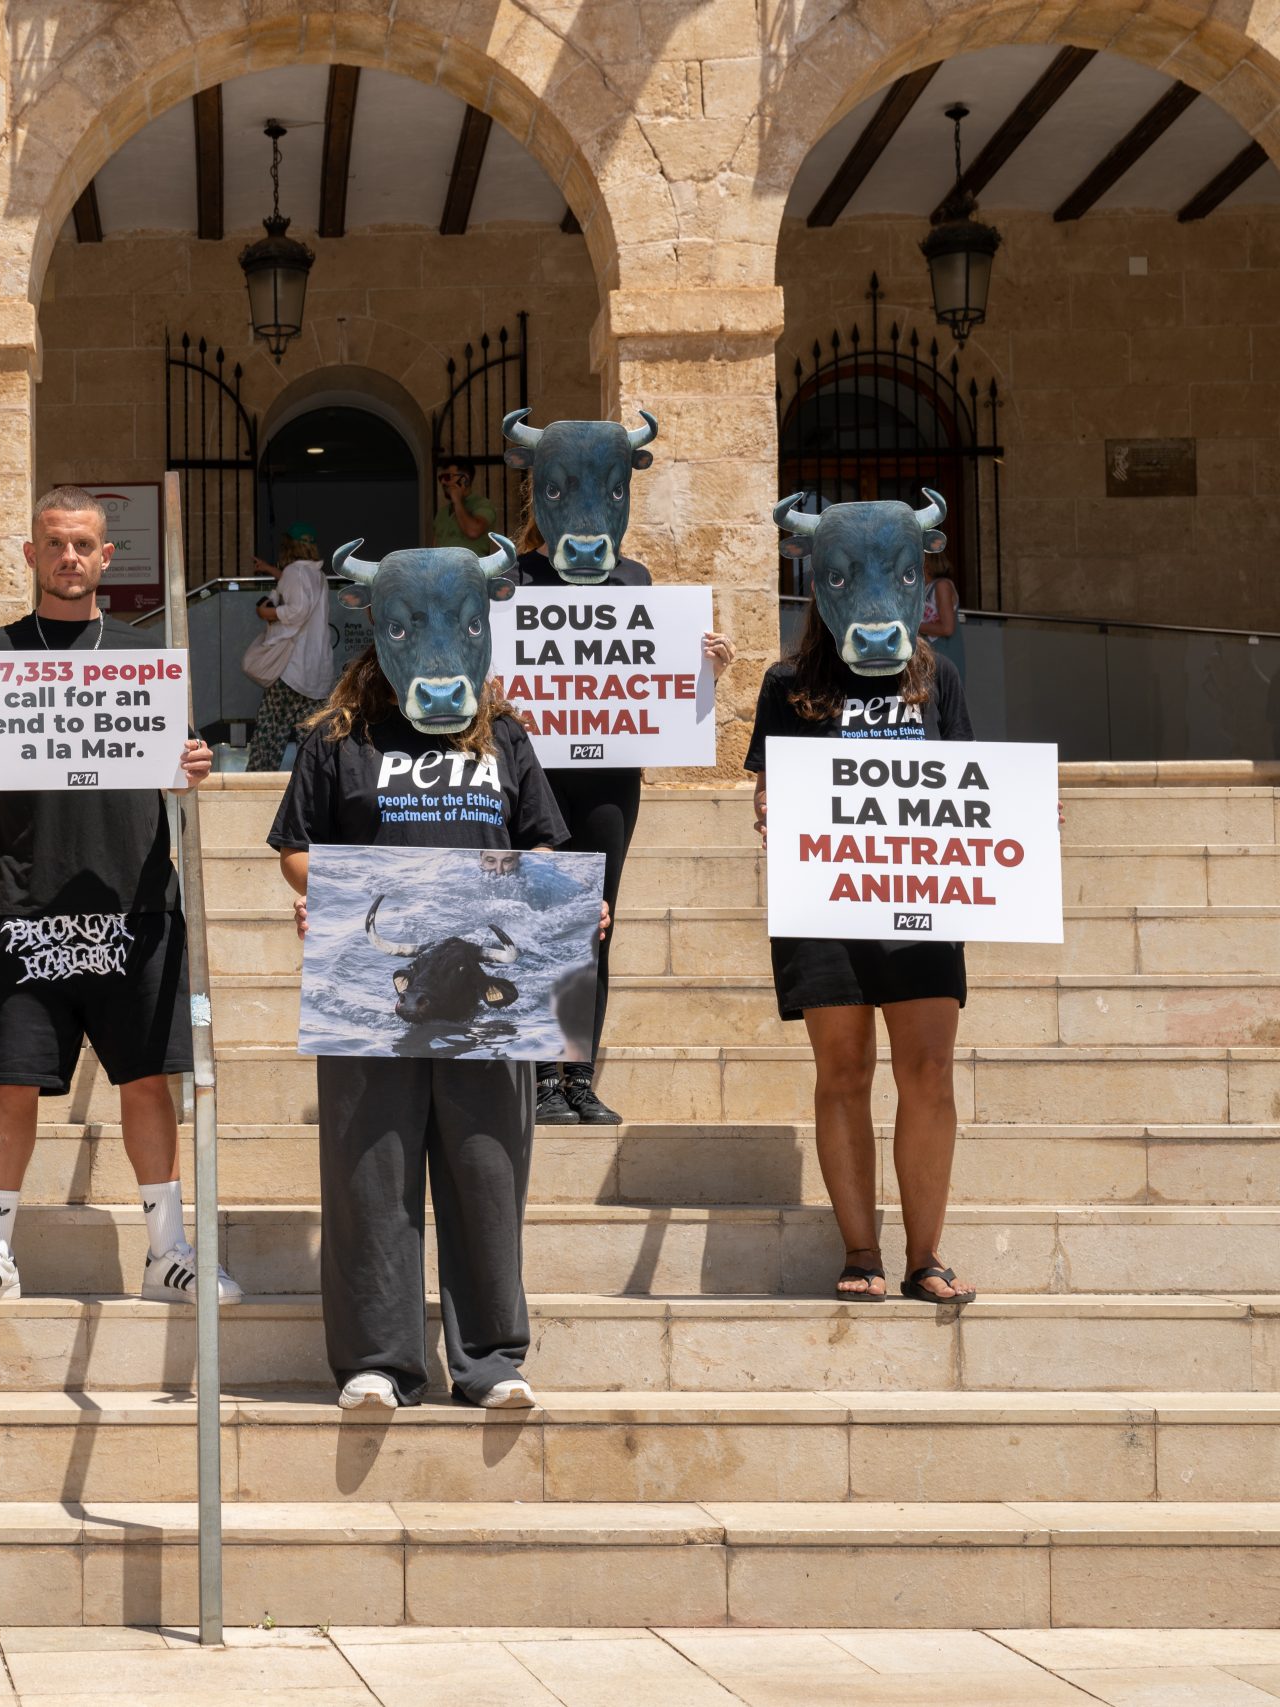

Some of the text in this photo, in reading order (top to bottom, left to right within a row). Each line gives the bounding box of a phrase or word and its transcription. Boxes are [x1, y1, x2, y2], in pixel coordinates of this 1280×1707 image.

[516, 604, 654, 630] BOUS A
[515, 640, 656, 665] LA MAR
[83, 659, 183, 686] people
[4, 686, 150, 708] call for an
[53, 714, 84, 733] to
[94, 712, 166, 733] Bous
[519, 709, 660, 736] ANIMAL
[870, 728, 882, 737] for
[883, 727, 898, 737] the
[899, 726, 925, 736] Ethical
[21, 738, 145, 760] a la Mar.
[832, 758, 990, 790] BOUS A
[377, 792, 502, 812] People for the Ethical
[831, 796, 992, 828] LA MAR
[381, 808, 503, 826] Treatment of Animals
[799, 834, 1025, 868] MALTRATO
[829, 873, 996, 905] ANIMAL
